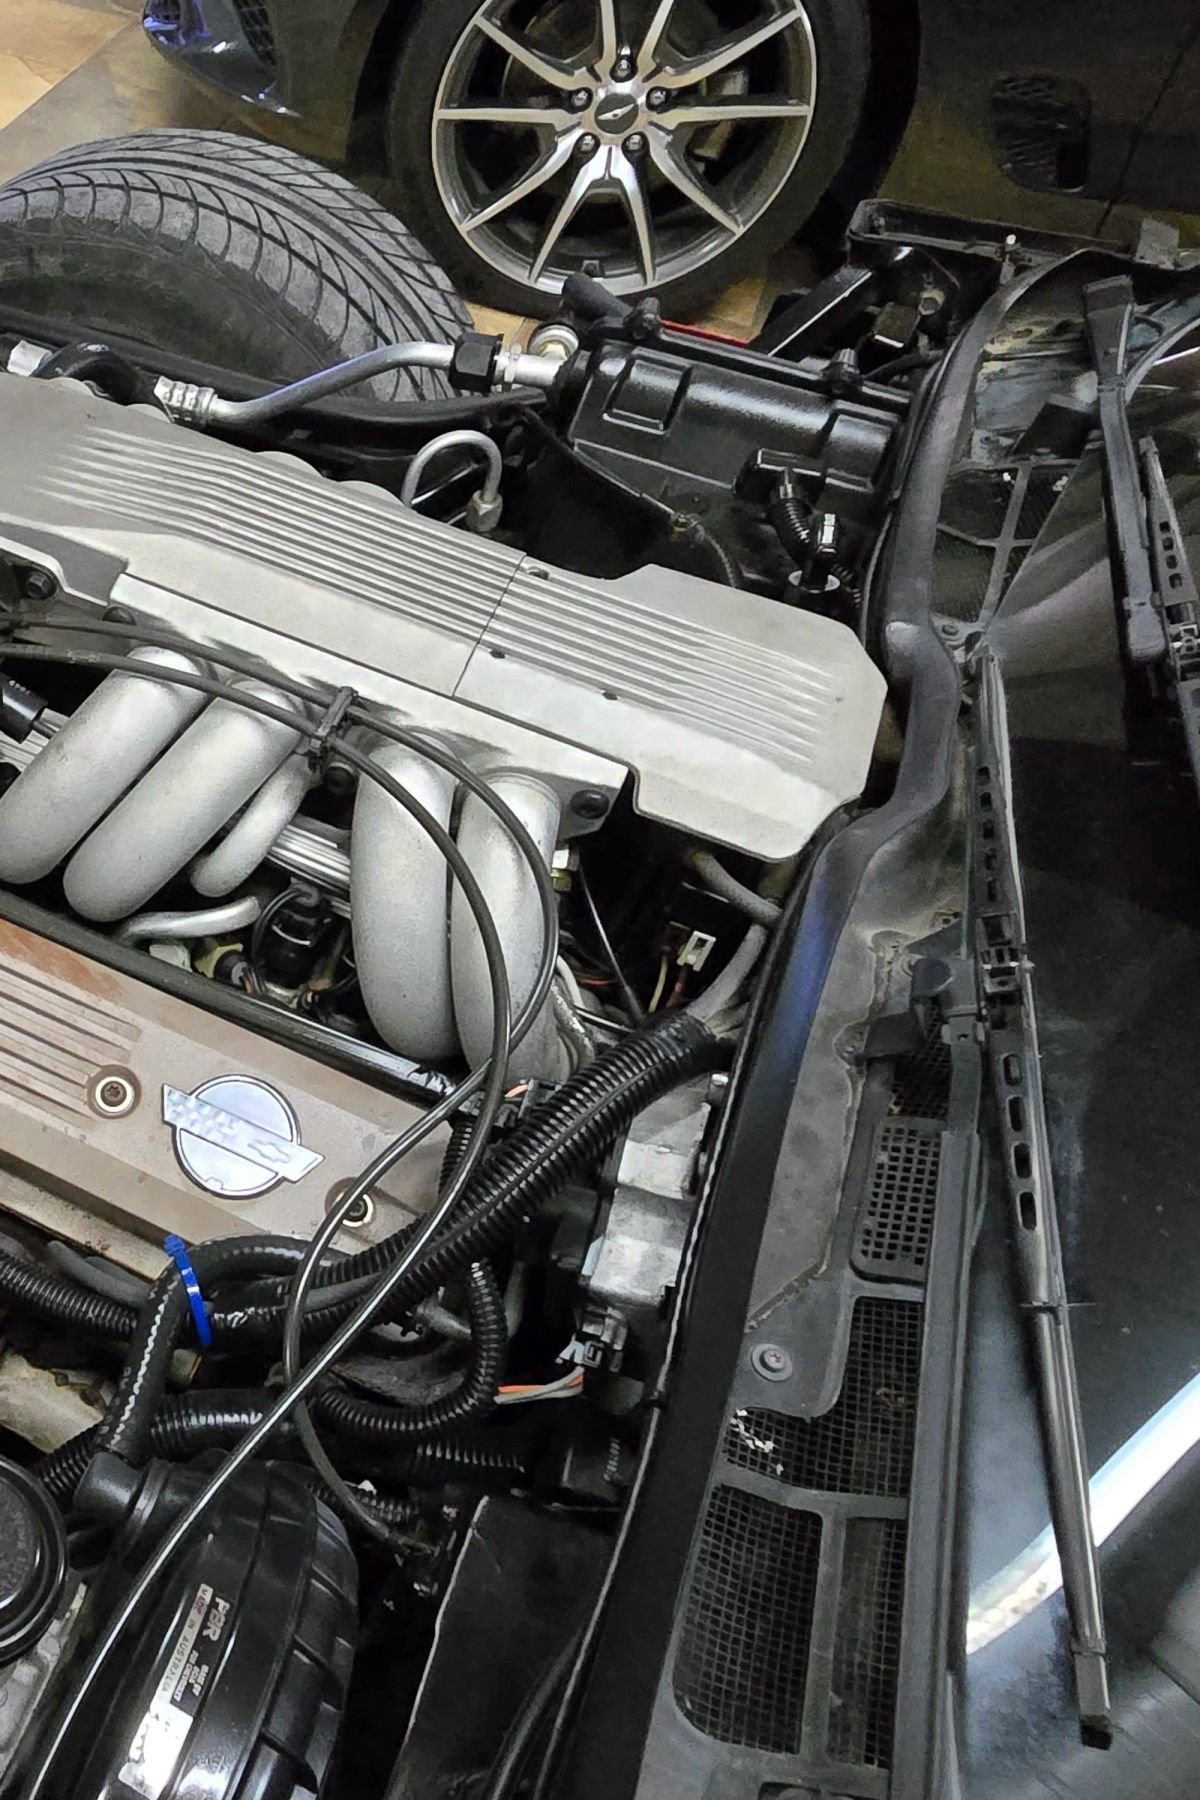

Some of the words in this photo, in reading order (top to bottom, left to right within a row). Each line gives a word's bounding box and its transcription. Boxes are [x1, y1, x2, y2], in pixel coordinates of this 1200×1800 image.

[187, 1617, 196, 1630] IN
[202, 1597, 230, 1641] PBR
[160, 1634, 191, 1693] AUSTRALIA
